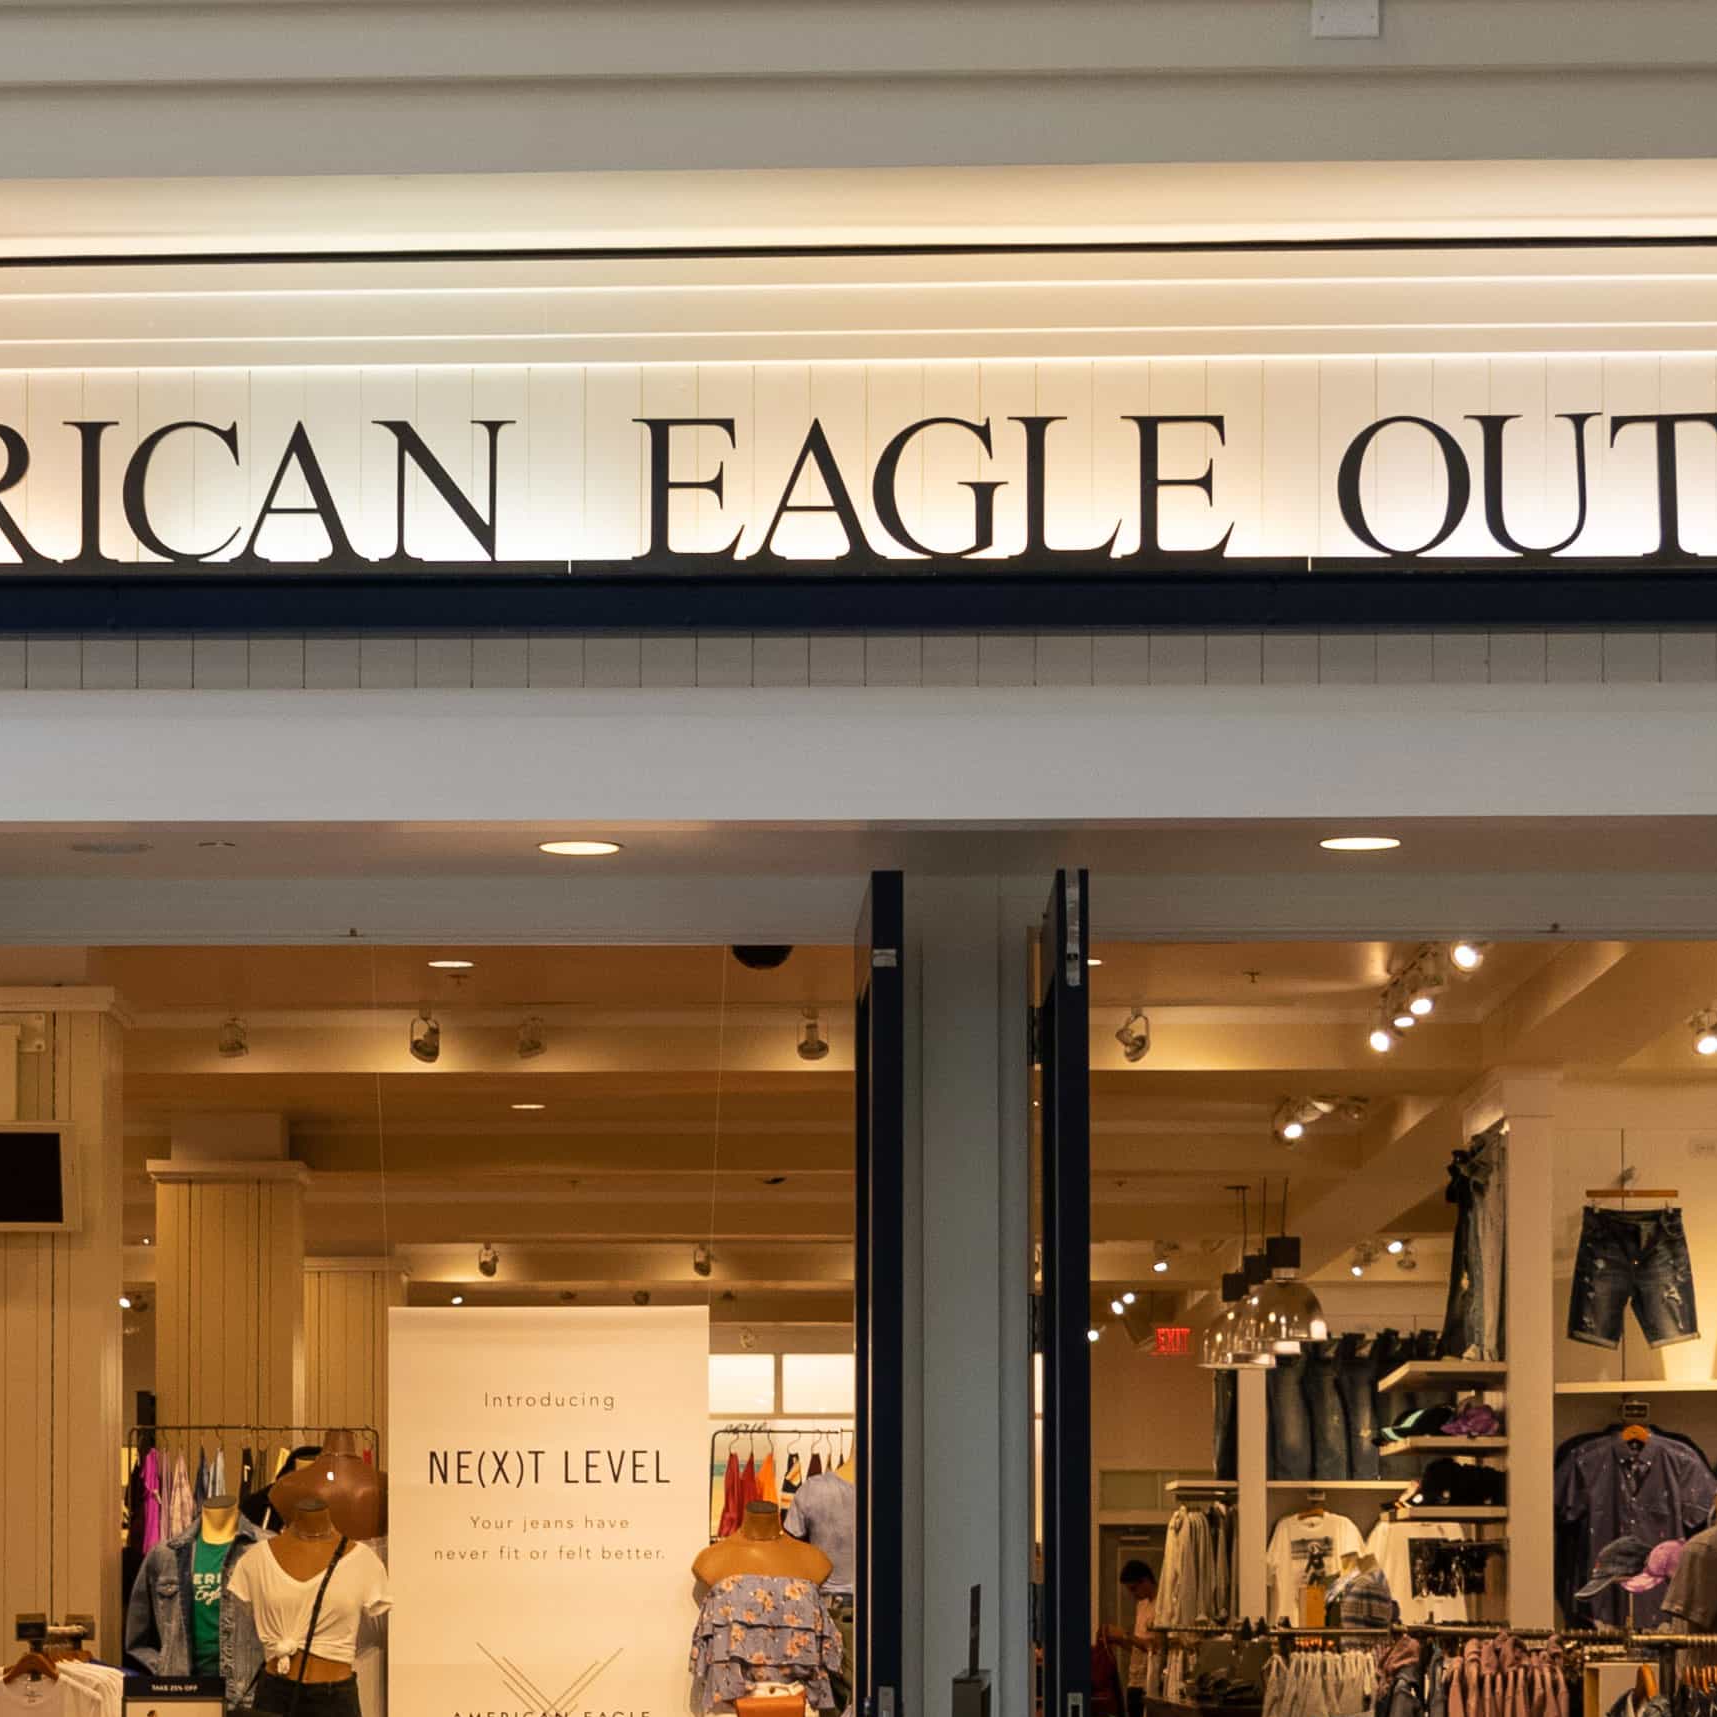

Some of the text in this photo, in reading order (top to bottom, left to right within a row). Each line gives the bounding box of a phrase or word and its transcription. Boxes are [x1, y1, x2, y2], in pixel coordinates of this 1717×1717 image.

[631, 414, 1234, 561] EAGLE
[1156, 1327, 1191, 1352] EXIT
[484, 1391, 615, 1411] Introducing
[429, 1450, 671, 1488] NE(X)T LEVEL
[469, 1515, 630, 1533] Your jeans have
[434, 1545, 666, 1560] never fit or felt better.
